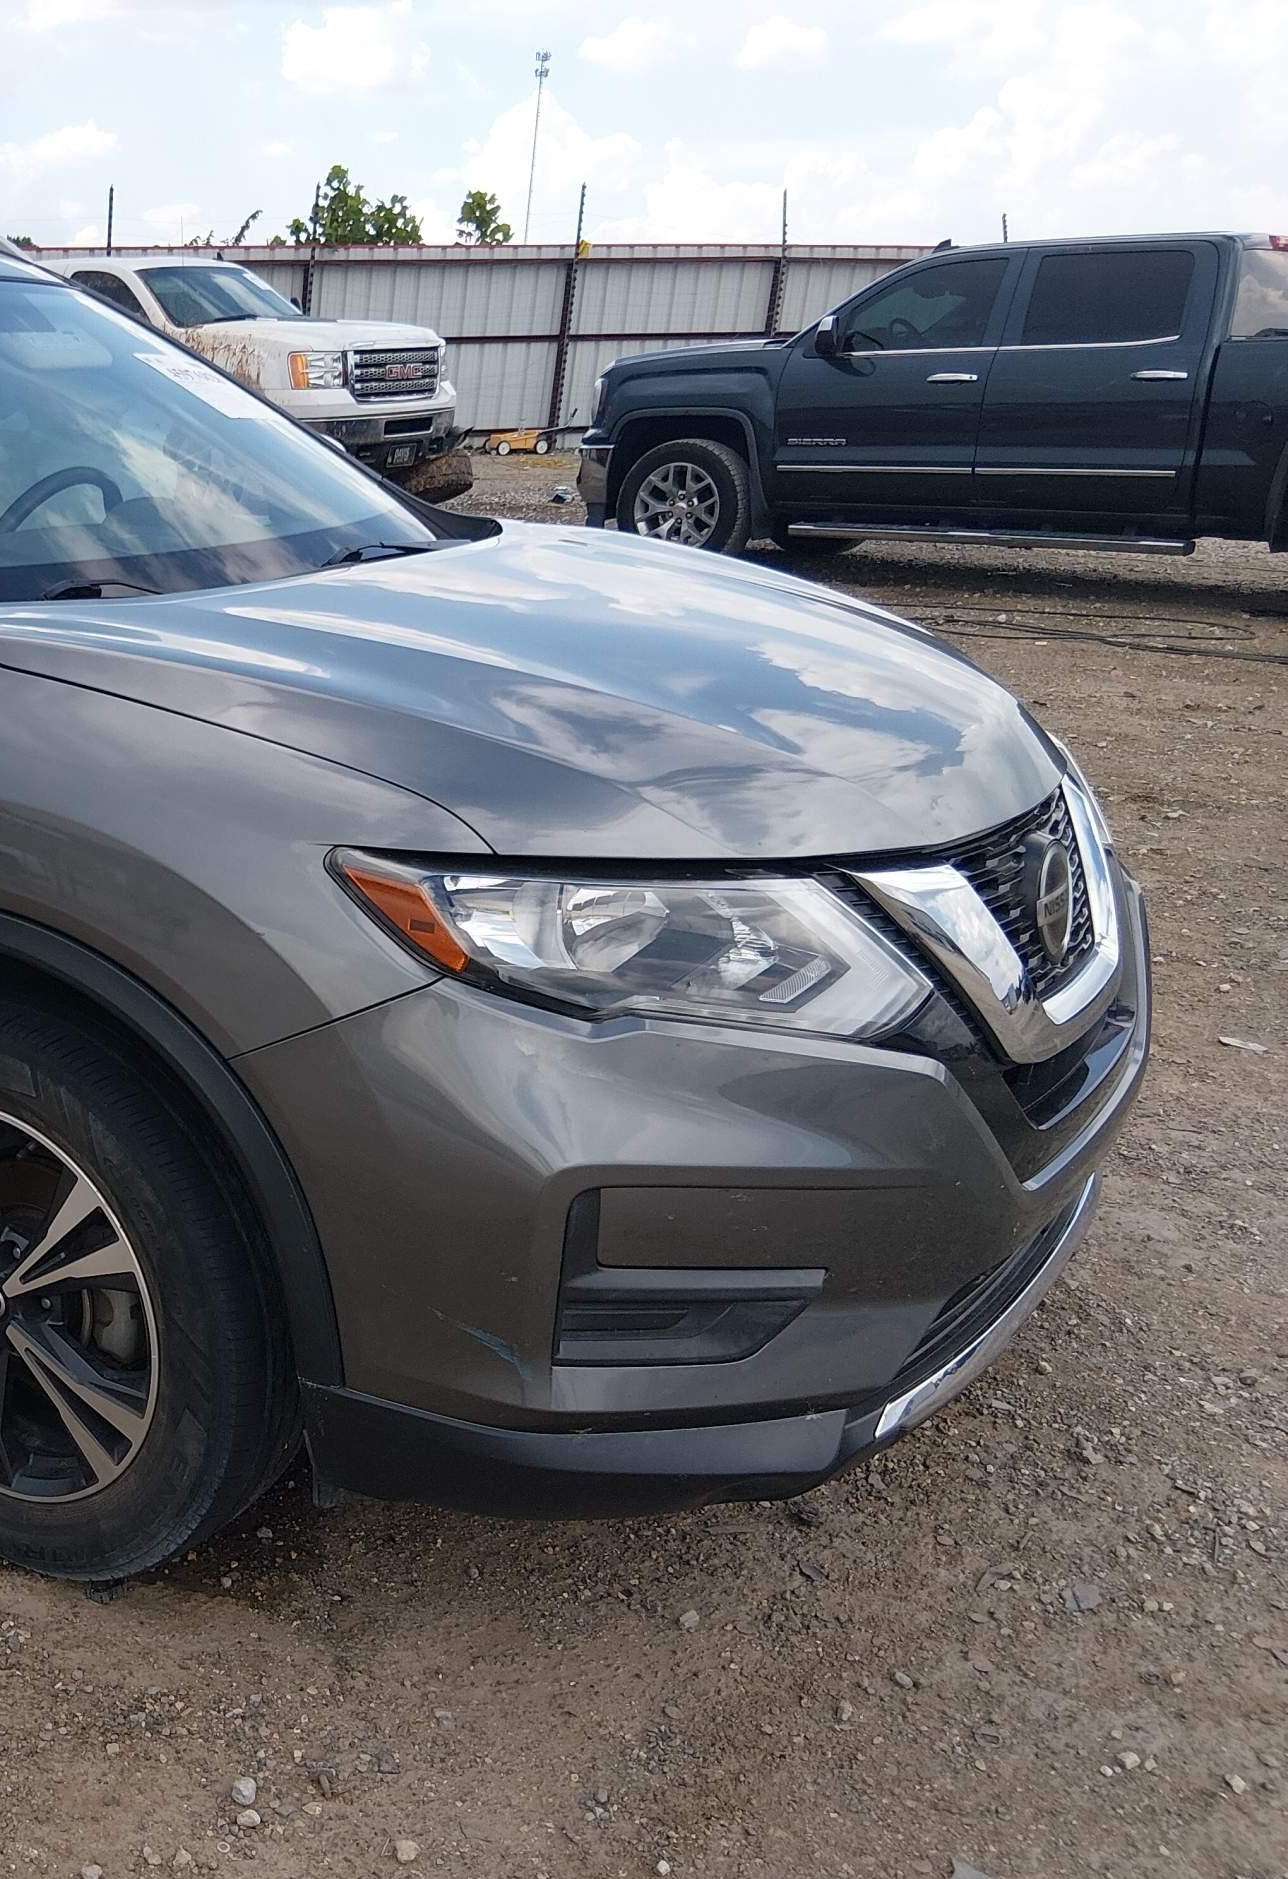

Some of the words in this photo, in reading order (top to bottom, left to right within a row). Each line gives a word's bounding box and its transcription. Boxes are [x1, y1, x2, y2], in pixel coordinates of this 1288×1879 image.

[386, 363, 423, 380] GMC
[787, 438, 846, 446] SIERRA
[1044, 892, 1066, 918] NISS
